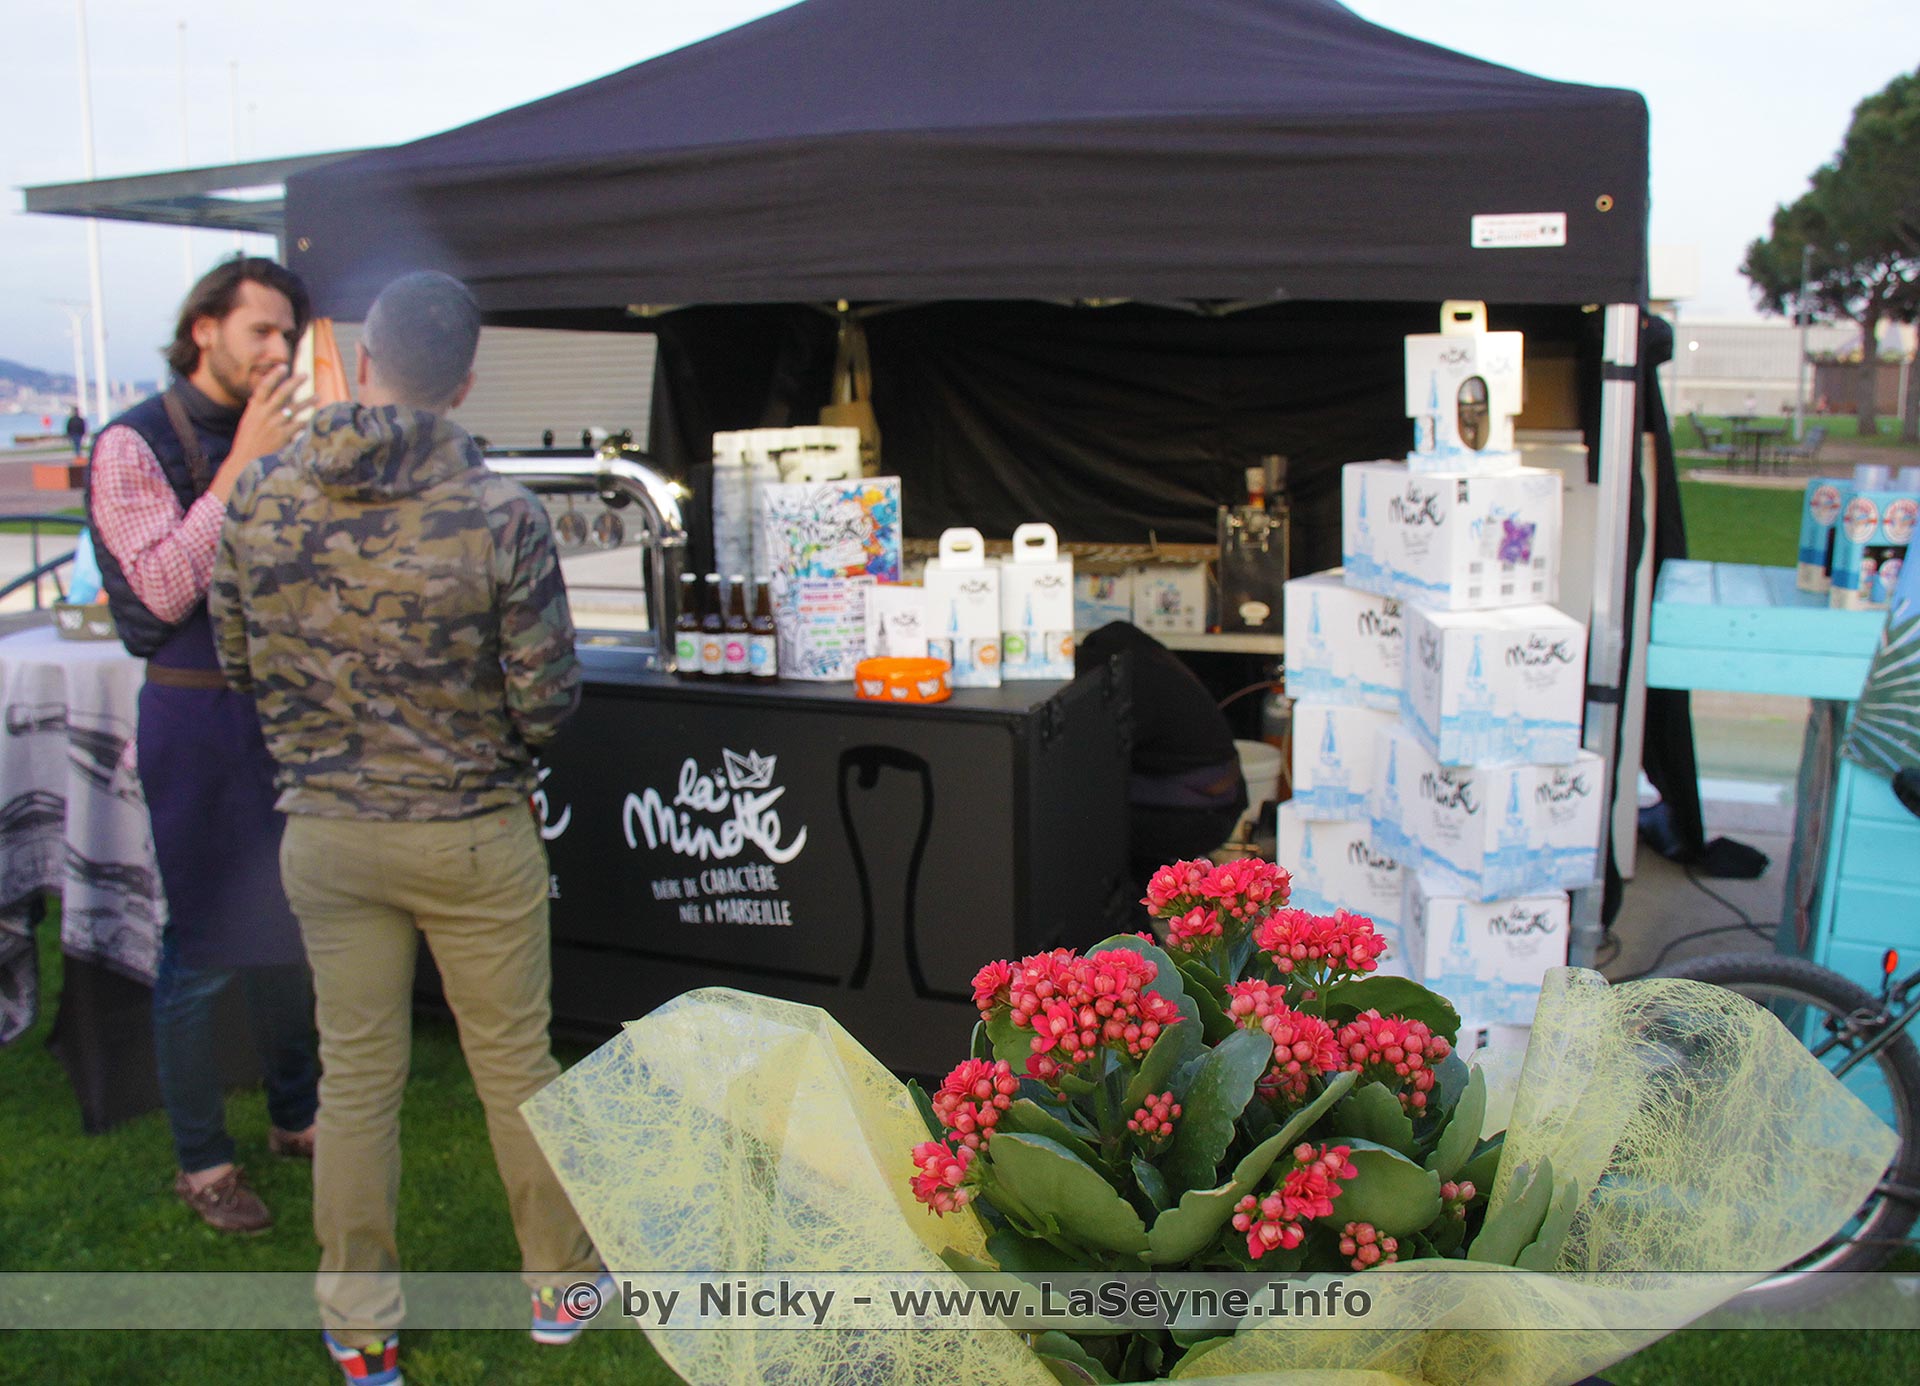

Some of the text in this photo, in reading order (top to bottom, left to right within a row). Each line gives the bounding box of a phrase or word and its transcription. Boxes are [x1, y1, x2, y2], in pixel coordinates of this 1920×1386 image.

[623, 786, 807, 864] Minotte
[683, 876, 700, 899] DE
[700, 862, 779, 895] CARACTÈRE
[716, 899, 793, 926] MARSEILLE
